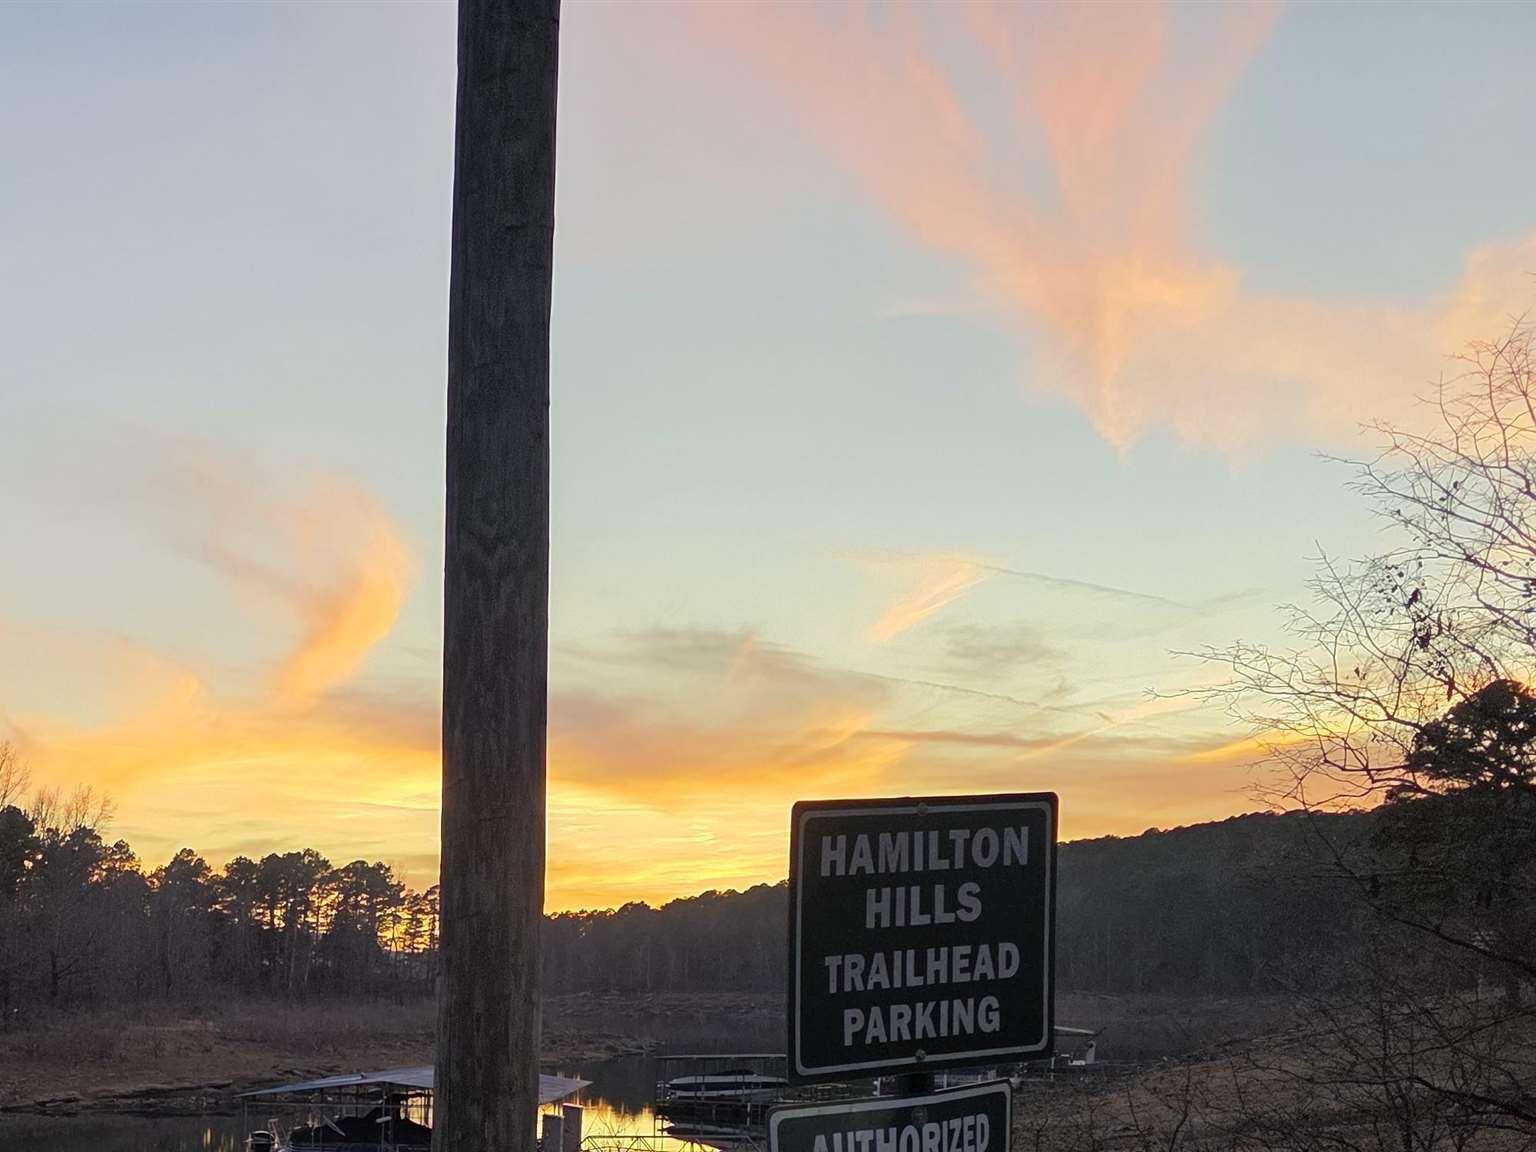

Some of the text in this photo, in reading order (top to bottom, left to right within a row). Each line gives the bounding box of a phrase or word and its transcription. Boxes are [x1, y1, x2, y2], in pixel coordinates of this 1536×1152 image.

[820, 827, 1029, 877] HAMILTON
[866, 882, 982, 929] HILLS
[825, 942, 1020, 994] TRAILHEAD
[843, 996, 1000, 1047] PARKING
